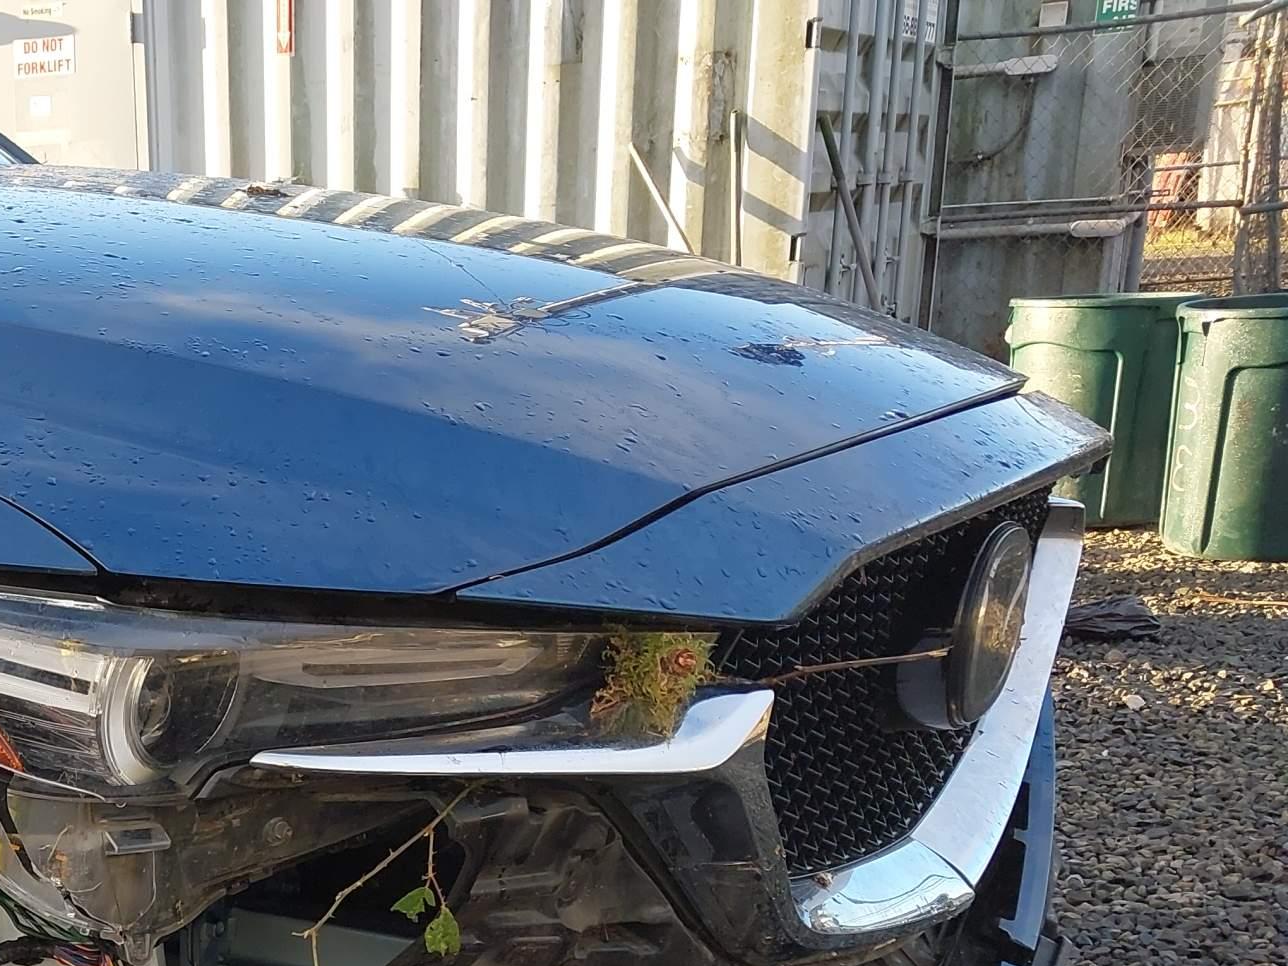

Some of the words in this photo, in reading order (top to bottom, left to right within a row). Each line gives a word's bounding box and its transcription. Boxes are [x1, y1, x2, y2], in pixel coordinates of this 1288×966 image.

[1101, 0, 1138, 14] FIRS
[23, 40, 38, 54] DO
[42, 38, 63, 52] NOT
[17, 58, 72, 76] FORKLIFT
